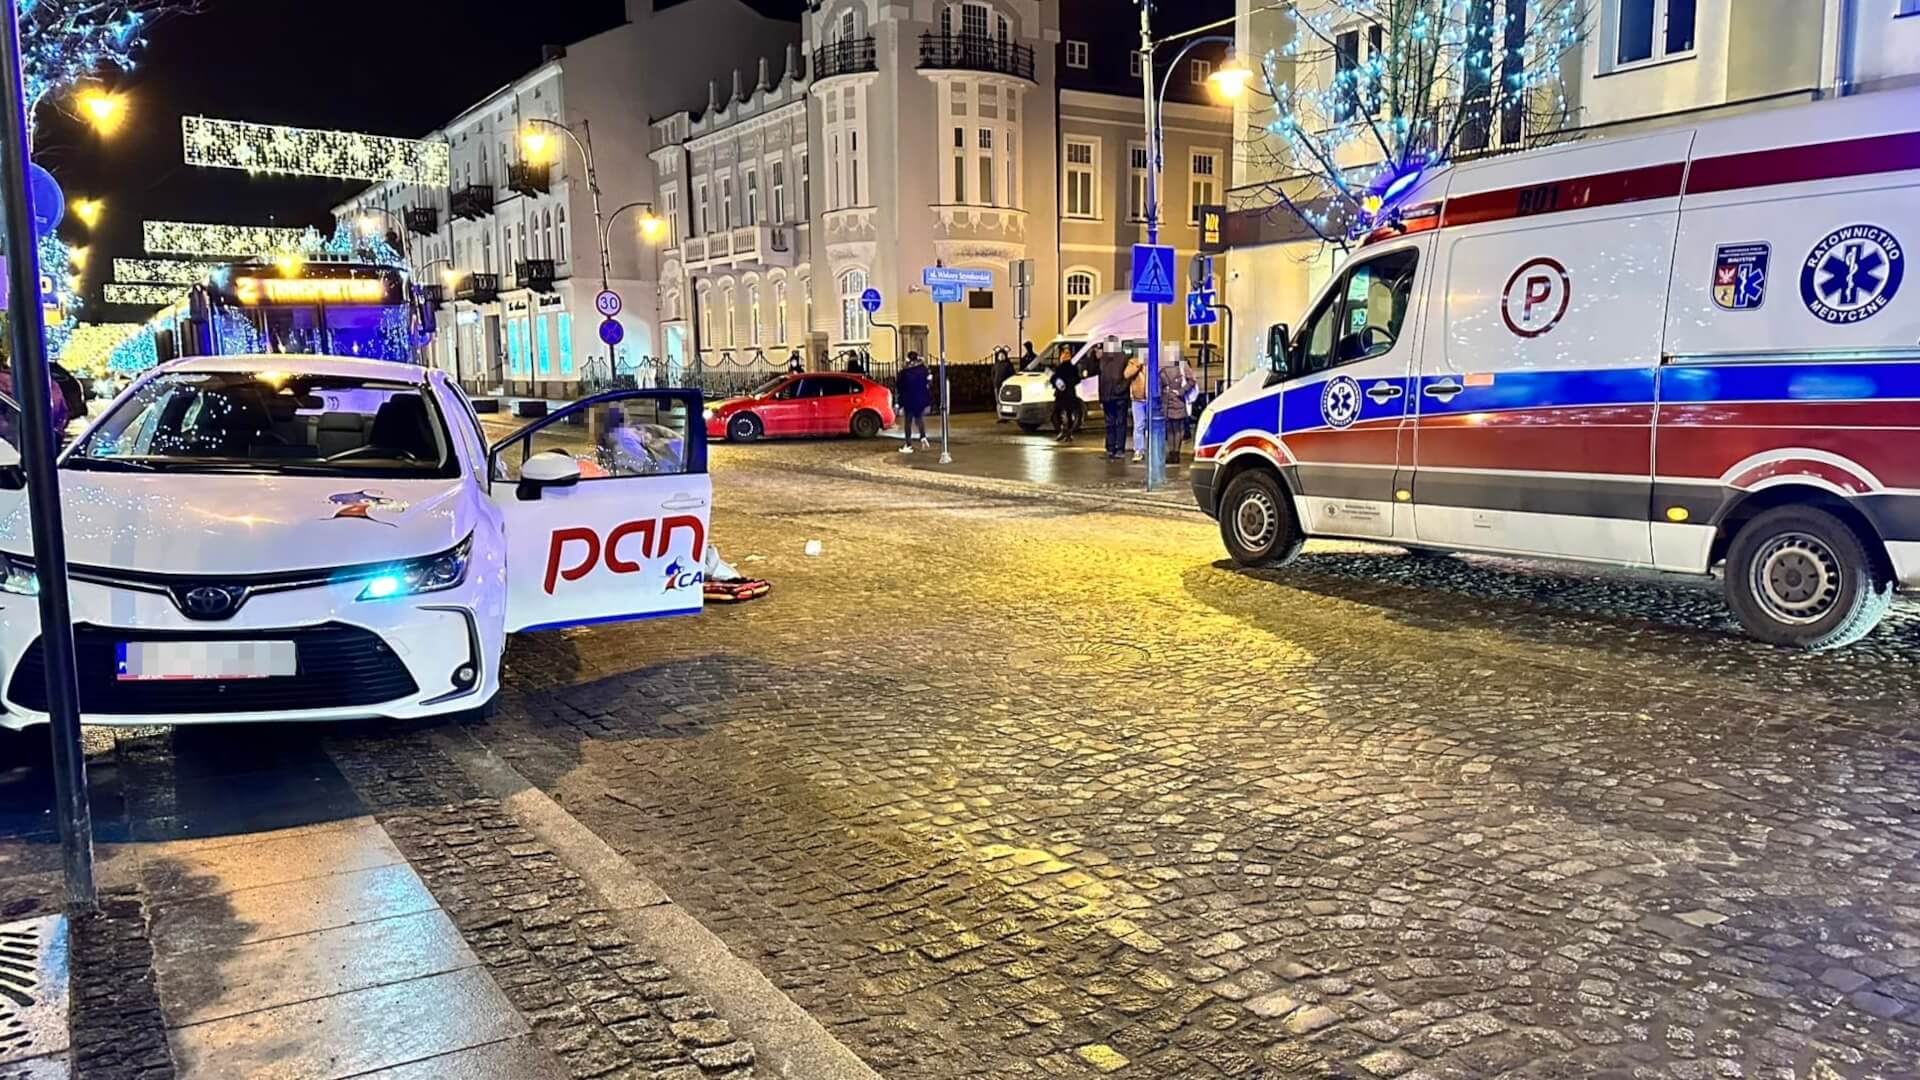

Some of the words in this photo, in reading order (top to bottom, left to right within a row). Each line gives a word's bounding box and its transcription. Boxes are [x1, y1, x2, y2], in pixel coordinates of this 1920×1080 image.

[1806, 226, 1901, 269] RATOWNICTWO
[600, 296, 618, 310] 30
[1523, 275, 1552, 321] P
[1808, 295, 1887, 322] MEDYCZNE
[544, 514, 705, 595] pan
